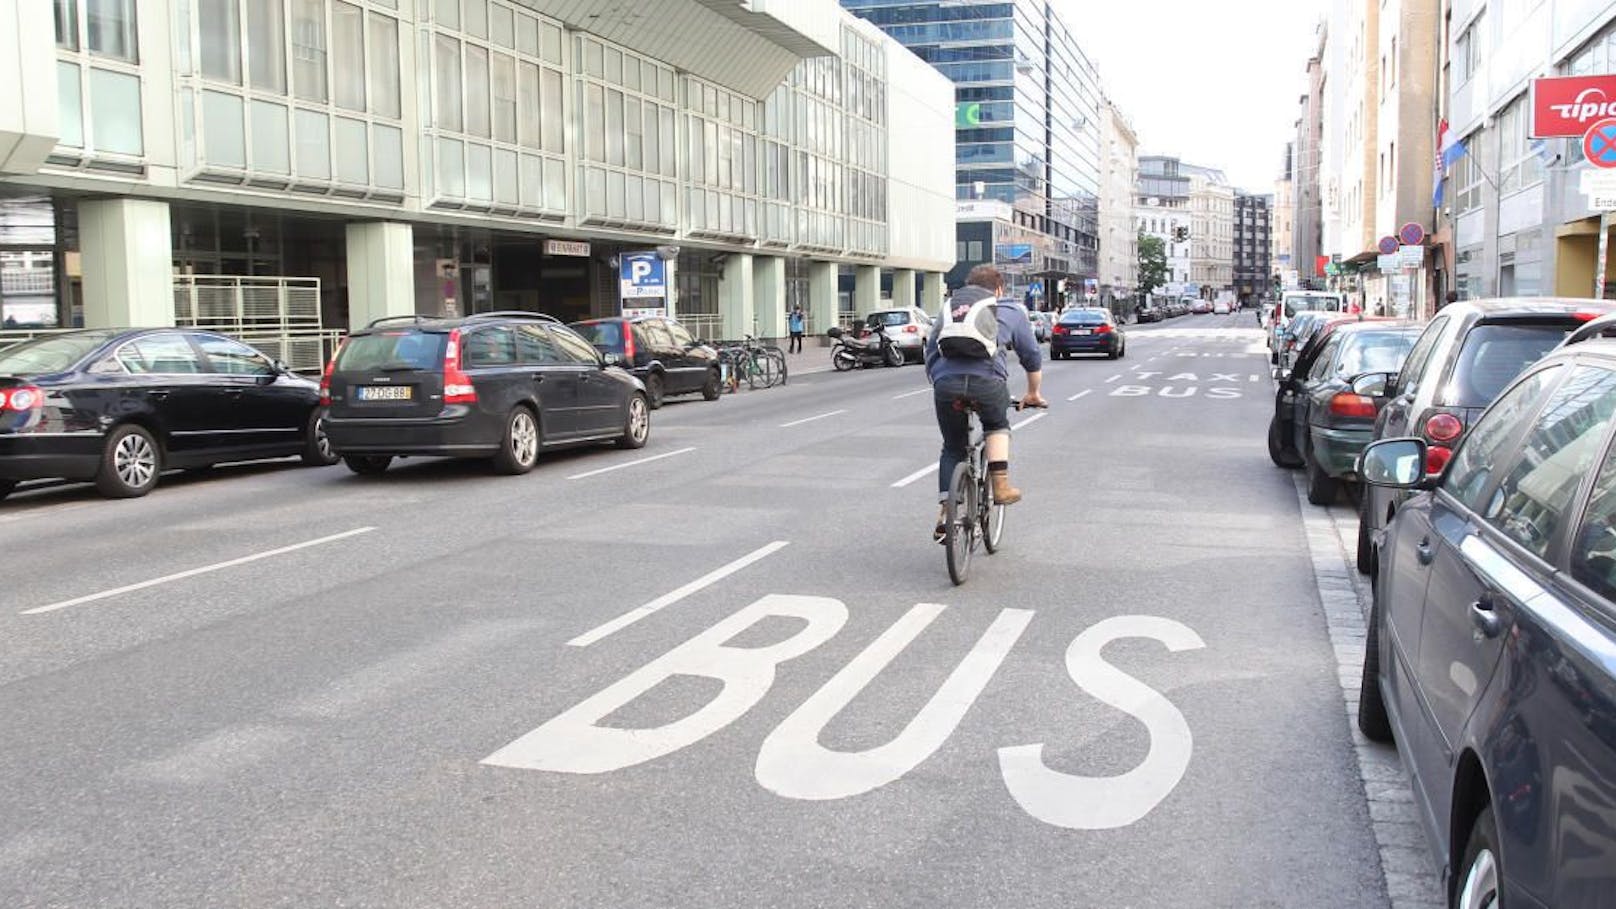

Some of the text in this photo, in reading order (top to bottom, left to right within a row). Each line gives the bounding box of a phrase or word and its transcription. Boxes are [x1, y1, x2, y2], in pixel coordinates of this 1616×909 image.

[632, 261, 652, 285] P
[1136, 371, 1259, 382] TAXI
[1108, 384, 1243, 399] BUS
[480, 593, 1206, 830] BUS
